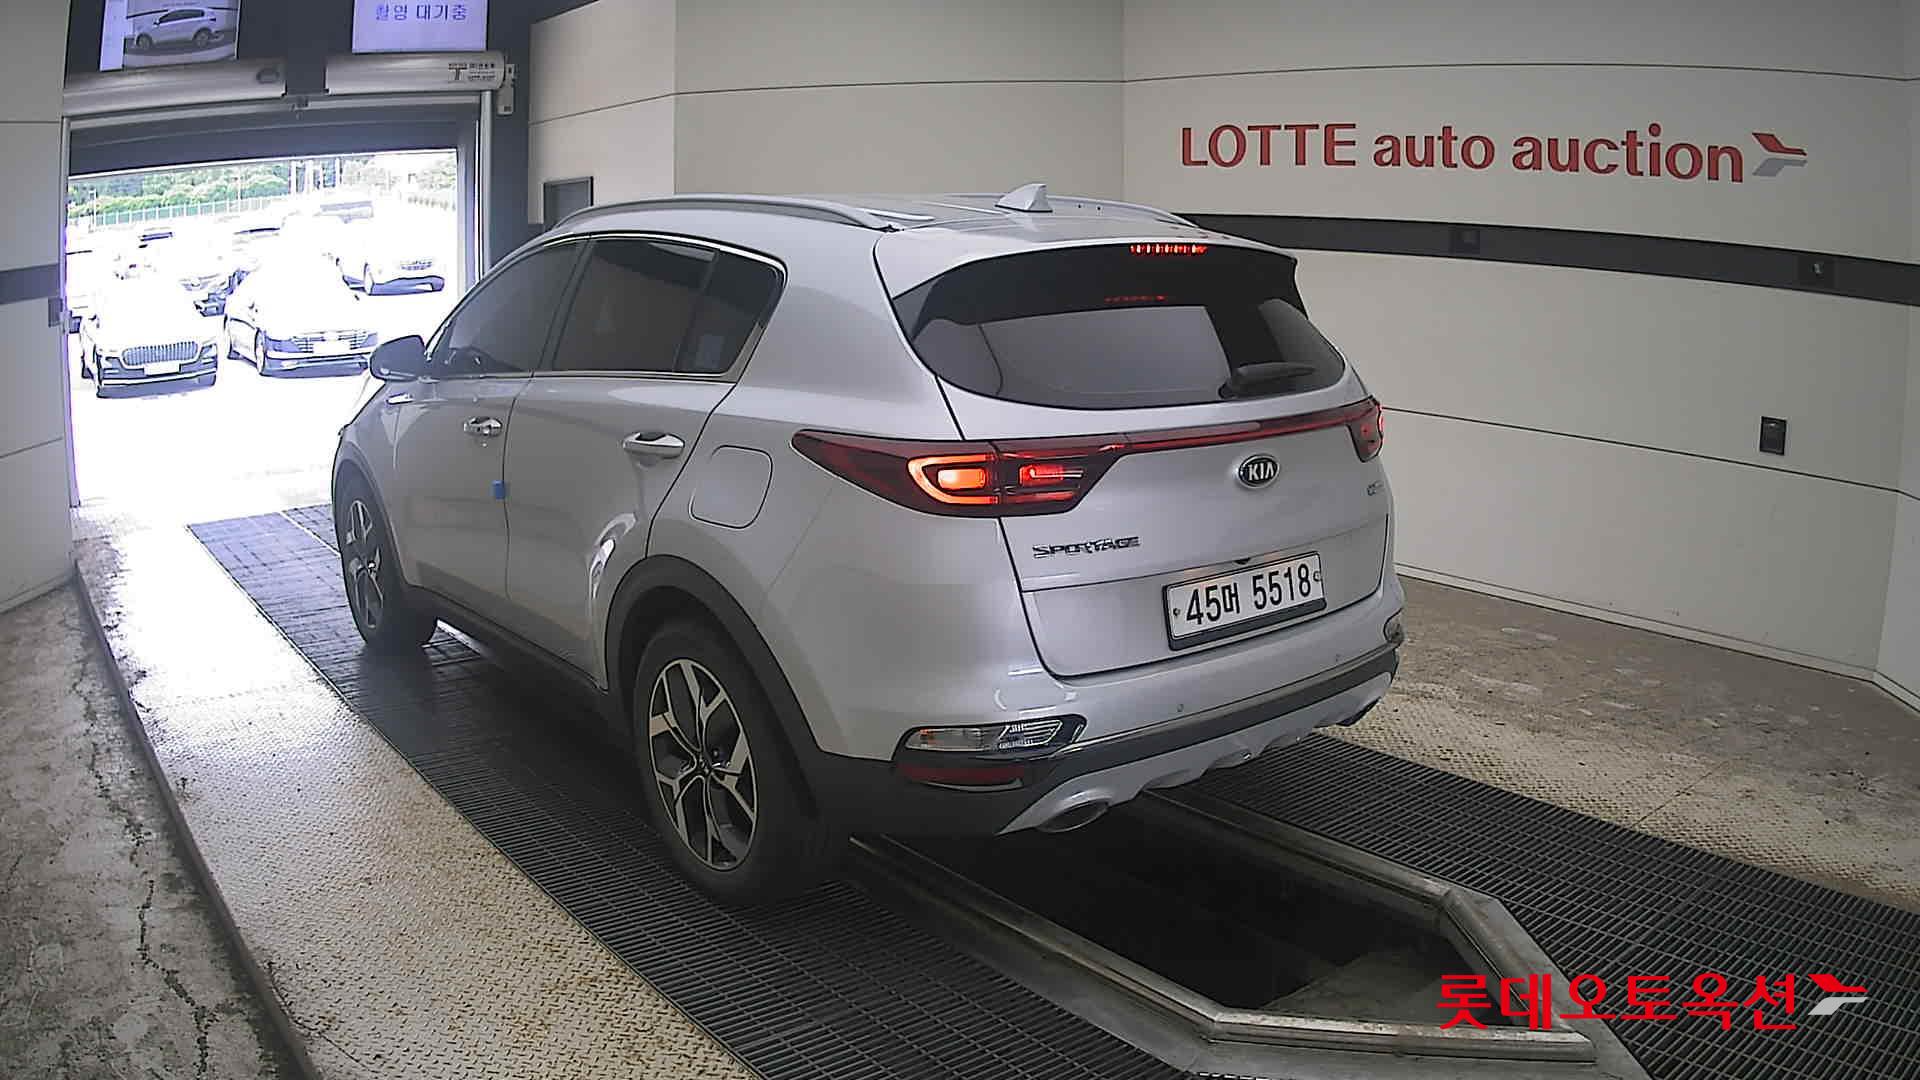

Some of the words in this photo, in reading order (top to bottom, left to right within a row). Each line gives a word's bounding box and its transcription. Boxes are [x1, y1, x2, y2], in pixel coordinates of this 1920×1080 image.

[1182, 123, 1356, 167] LOTTE
[1373, 125, 1496, 170] auto
[1512, 122, 1744, 184] auction
[1031, 536, 1141, 559] SPORTAGE
[1252, 563, 1312, 610] 5518
